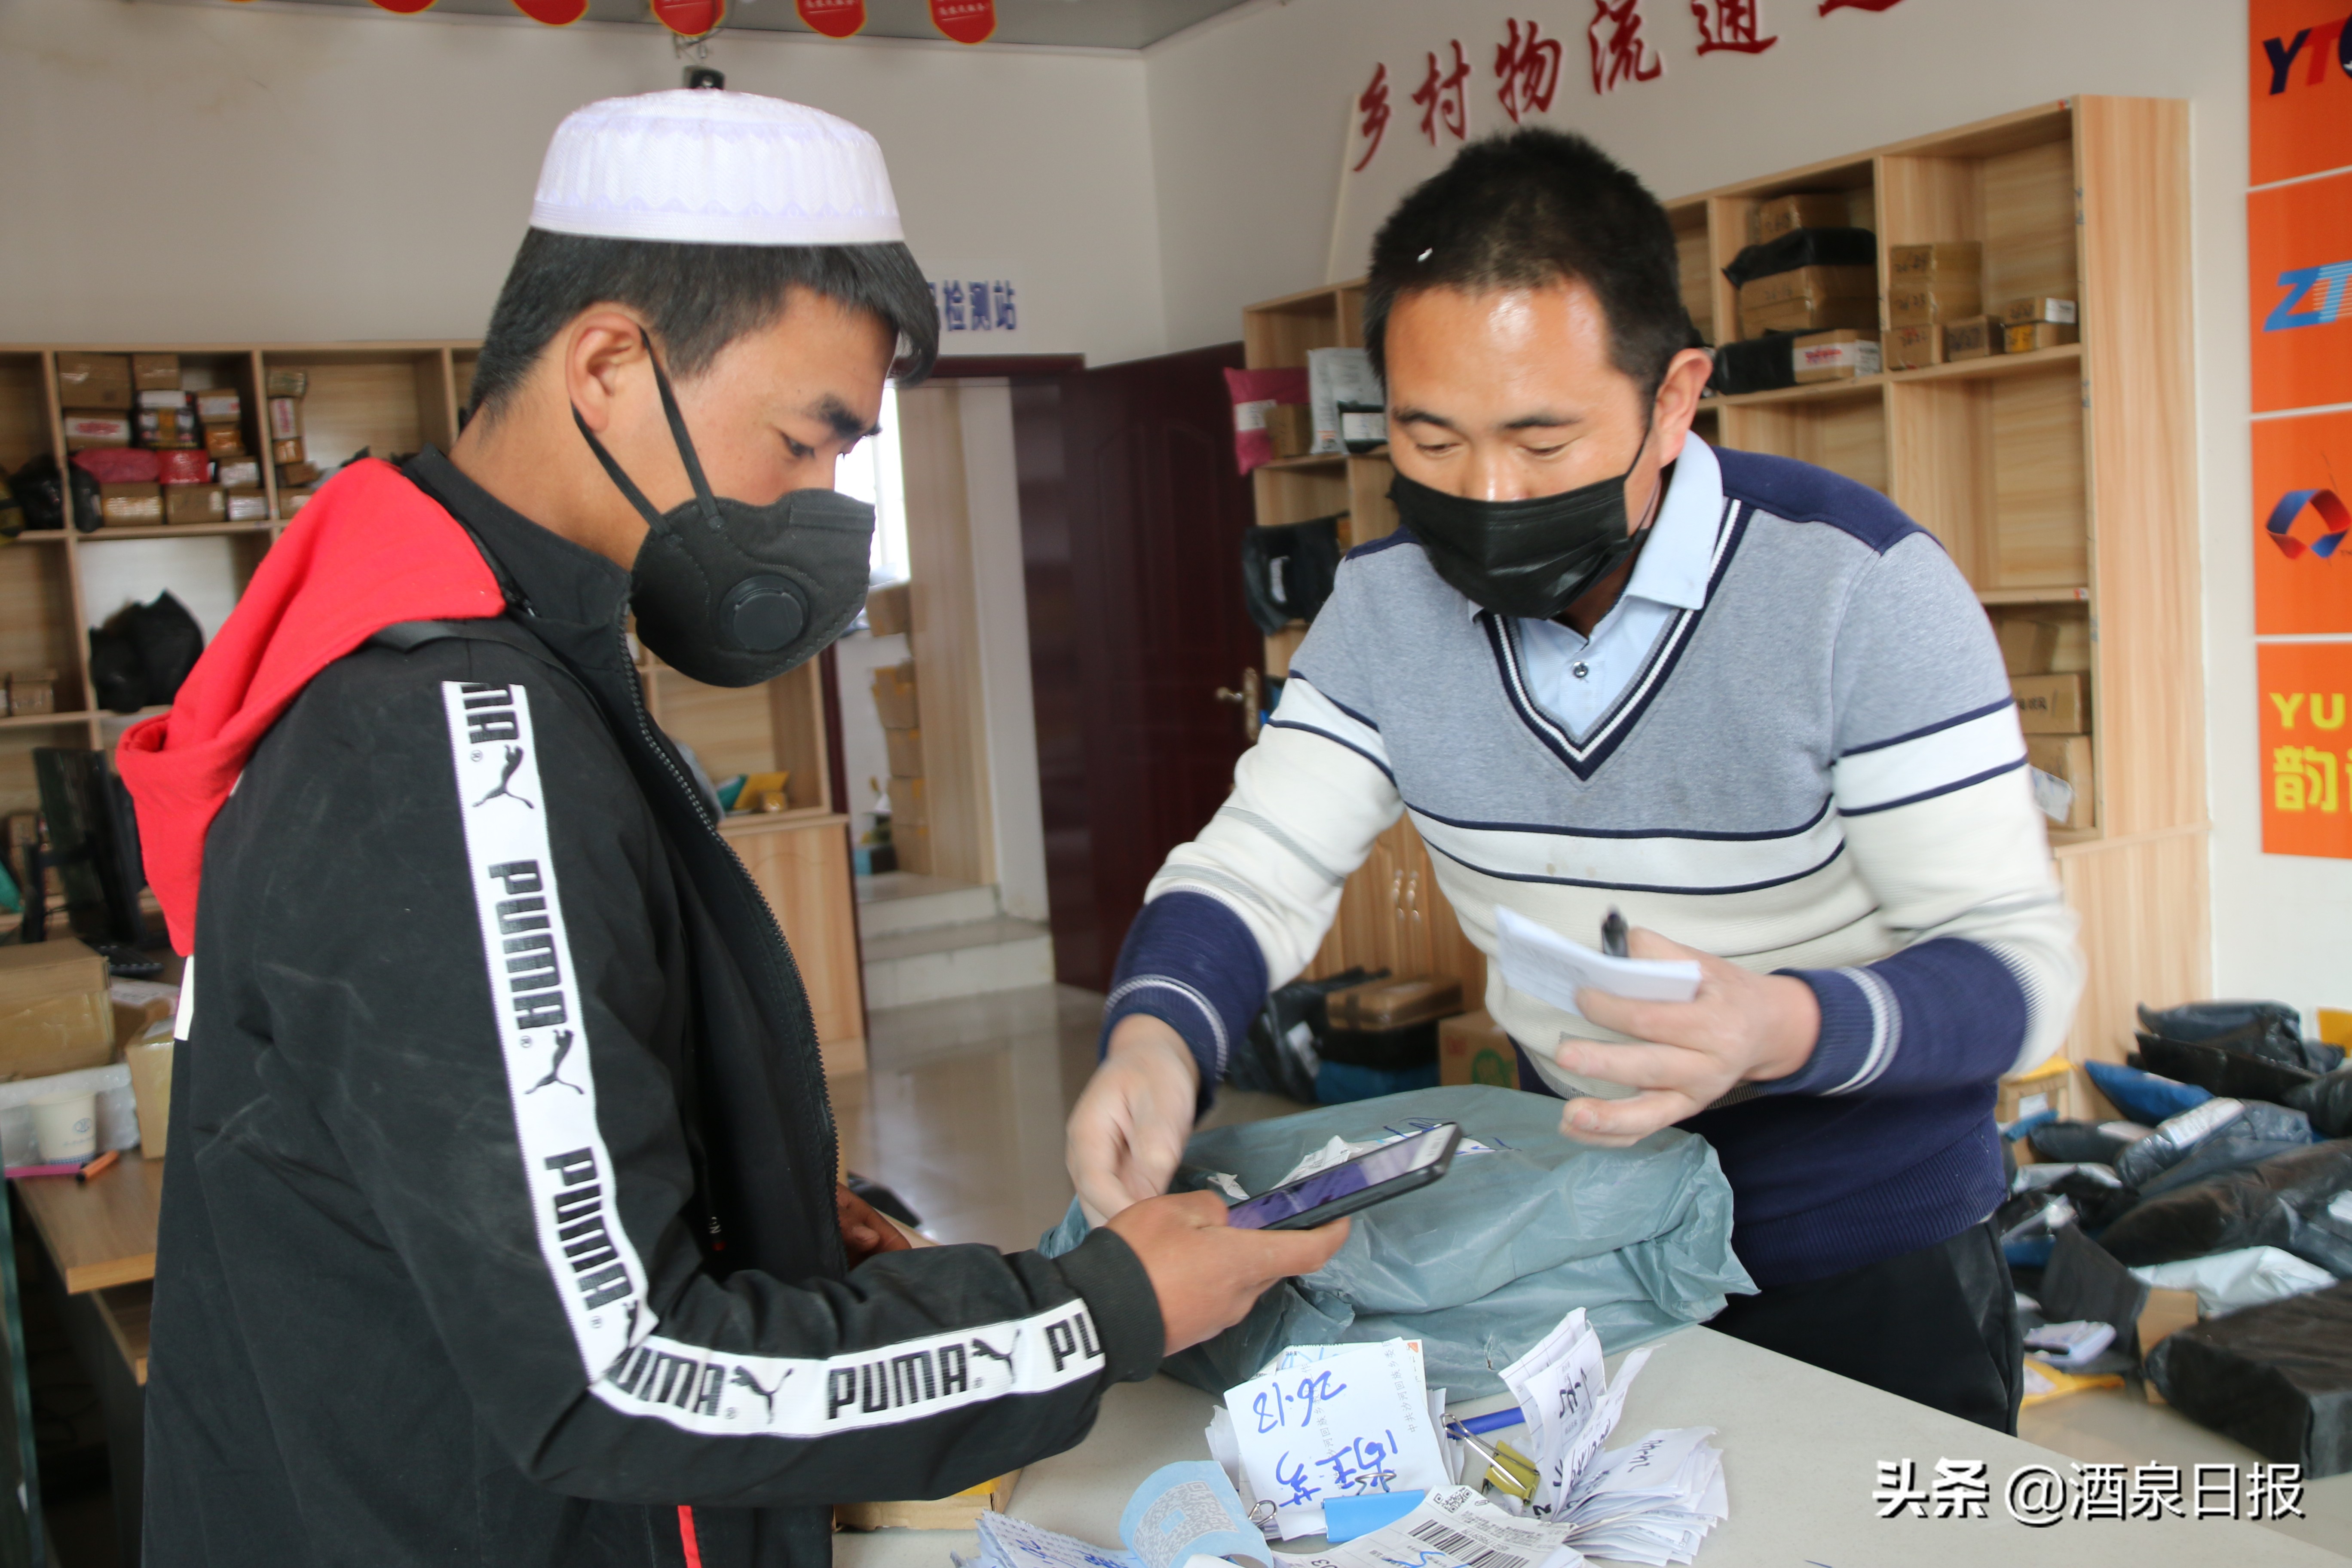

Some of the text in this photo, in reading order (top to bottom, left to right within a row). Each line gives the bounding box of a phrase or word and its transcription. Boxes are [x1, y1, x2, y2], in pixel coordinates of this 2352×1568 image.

[1354, 0, 1904, 173] 乡村物流通
[928, 279, 1016, 331] 检测站
[2273, 744, 2352, 812] 韵
[488, 859, 567, 1030] PUMA
[544, 1146, 634, 1310] PUMA
[828, 1343, 967, 1419] PUMA
